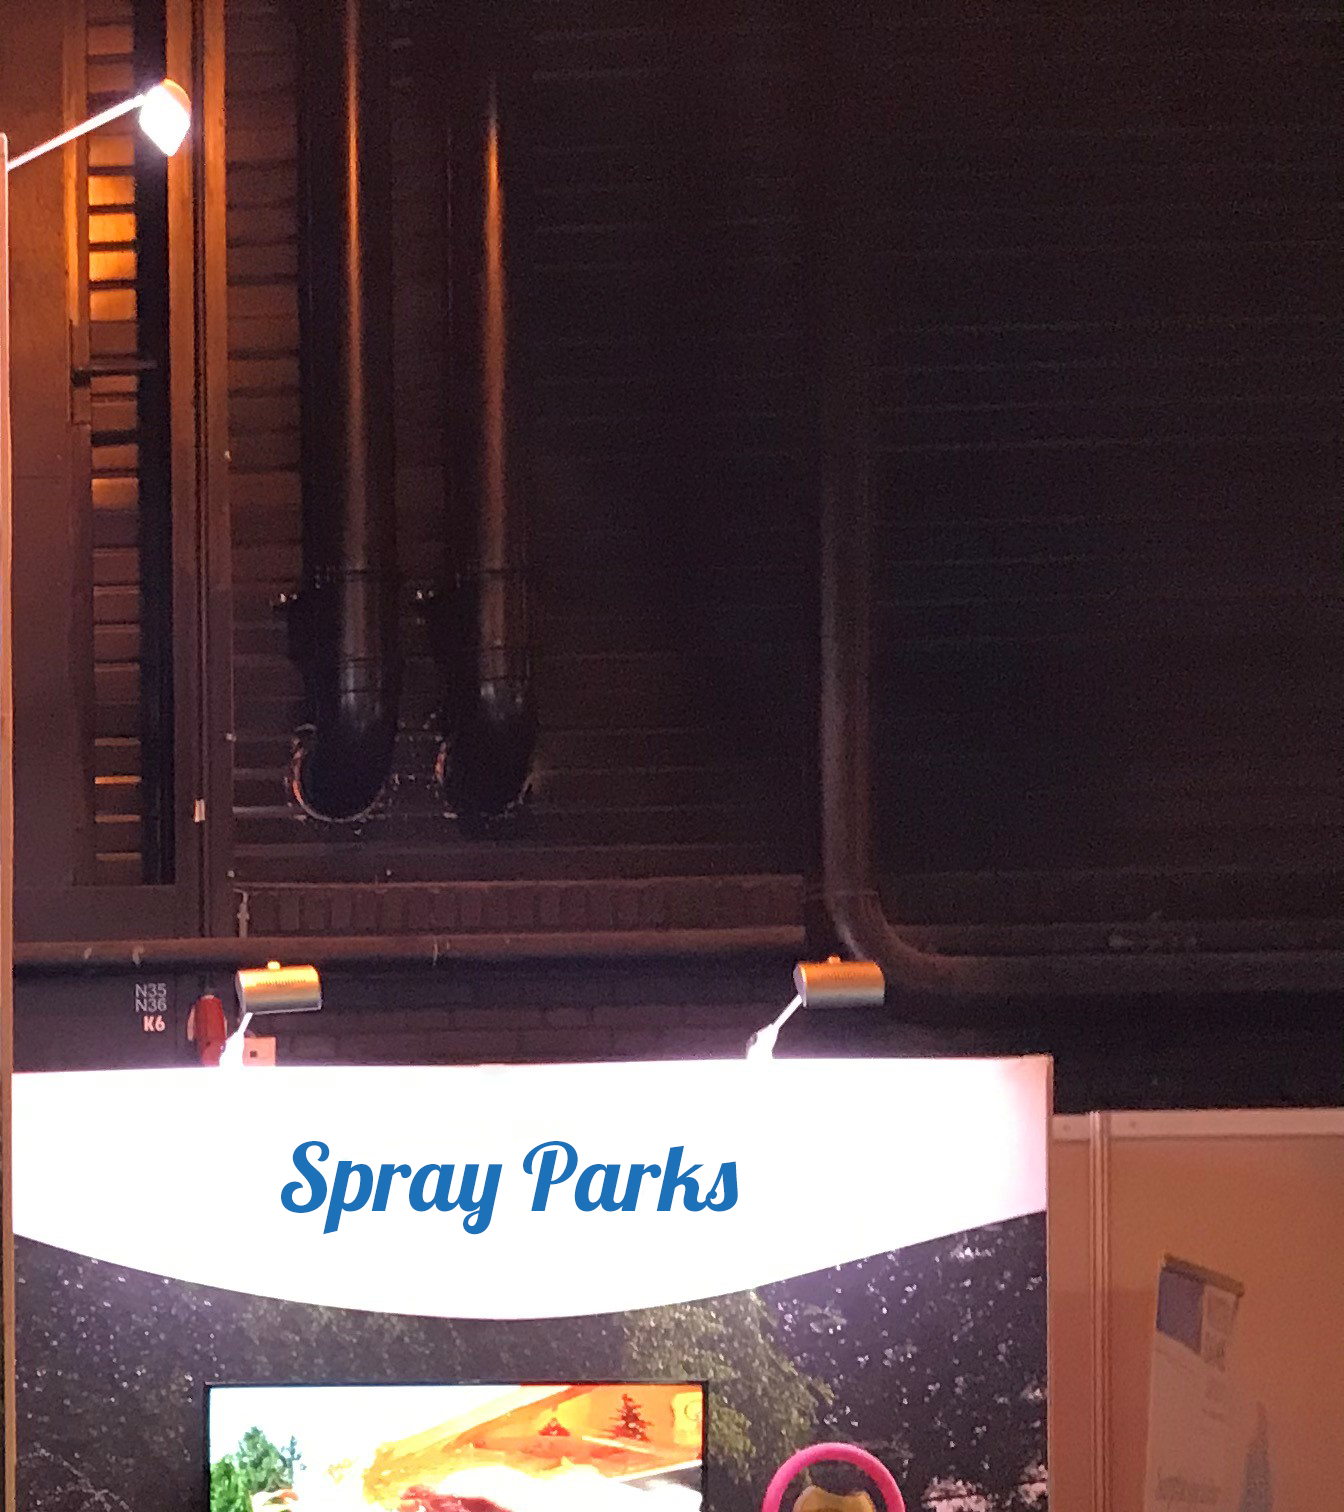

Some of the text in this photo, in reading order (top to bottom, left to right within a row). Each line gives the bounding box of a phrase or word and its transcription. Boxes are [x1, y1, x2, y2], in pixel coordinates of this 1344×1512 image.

[135, 982, 167, 998] N35
[135, 998, 167, 1012] N36
[143, 1014, 166, 1032] K6
[280, 1140, 739, 1236] Spray Parks
